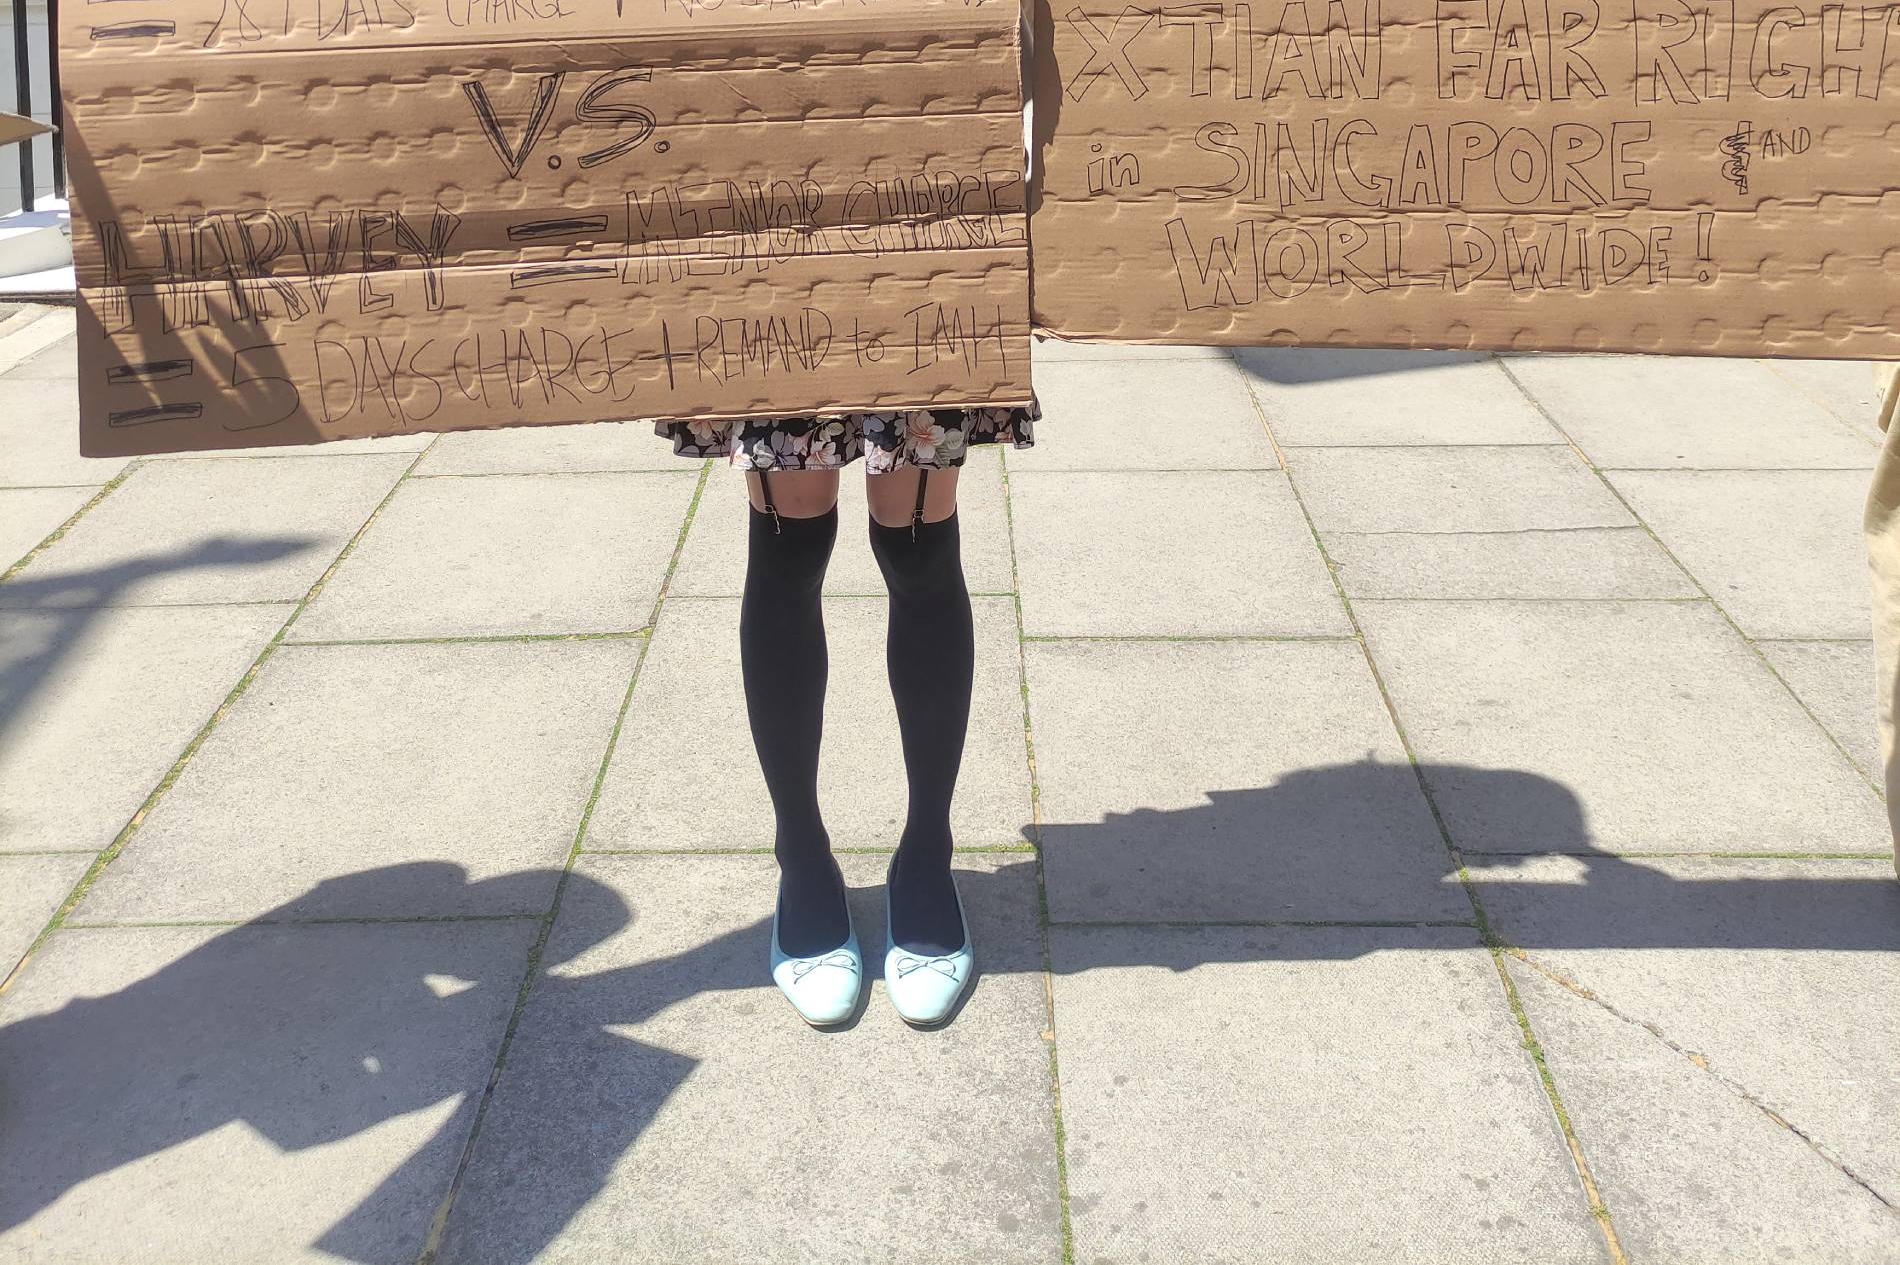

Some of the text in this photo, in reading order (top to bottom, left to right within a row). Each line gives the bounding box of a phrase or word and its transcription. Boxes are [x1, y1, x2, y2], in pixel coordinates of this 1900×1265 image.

[462, 65, 671, 179] V.S.
[1087, 143, 1140, 194] in
[1173, 117, 1652, 214] SINGAPORE
[1762, 126, 1812, 160] AND
[98, 202, 463, 339] HARVEY
[621, 178, 832, 286] MINOR
[840, 169, 1029, 260] CHARGE
[313, 335, 443, 426] DAYS
[453, 326, 638, 405] CHARGE
[695, 306, 833, 387] REMAND
[846, 317, 896, 369] to
[904, 301, 1007, 379] IMH
